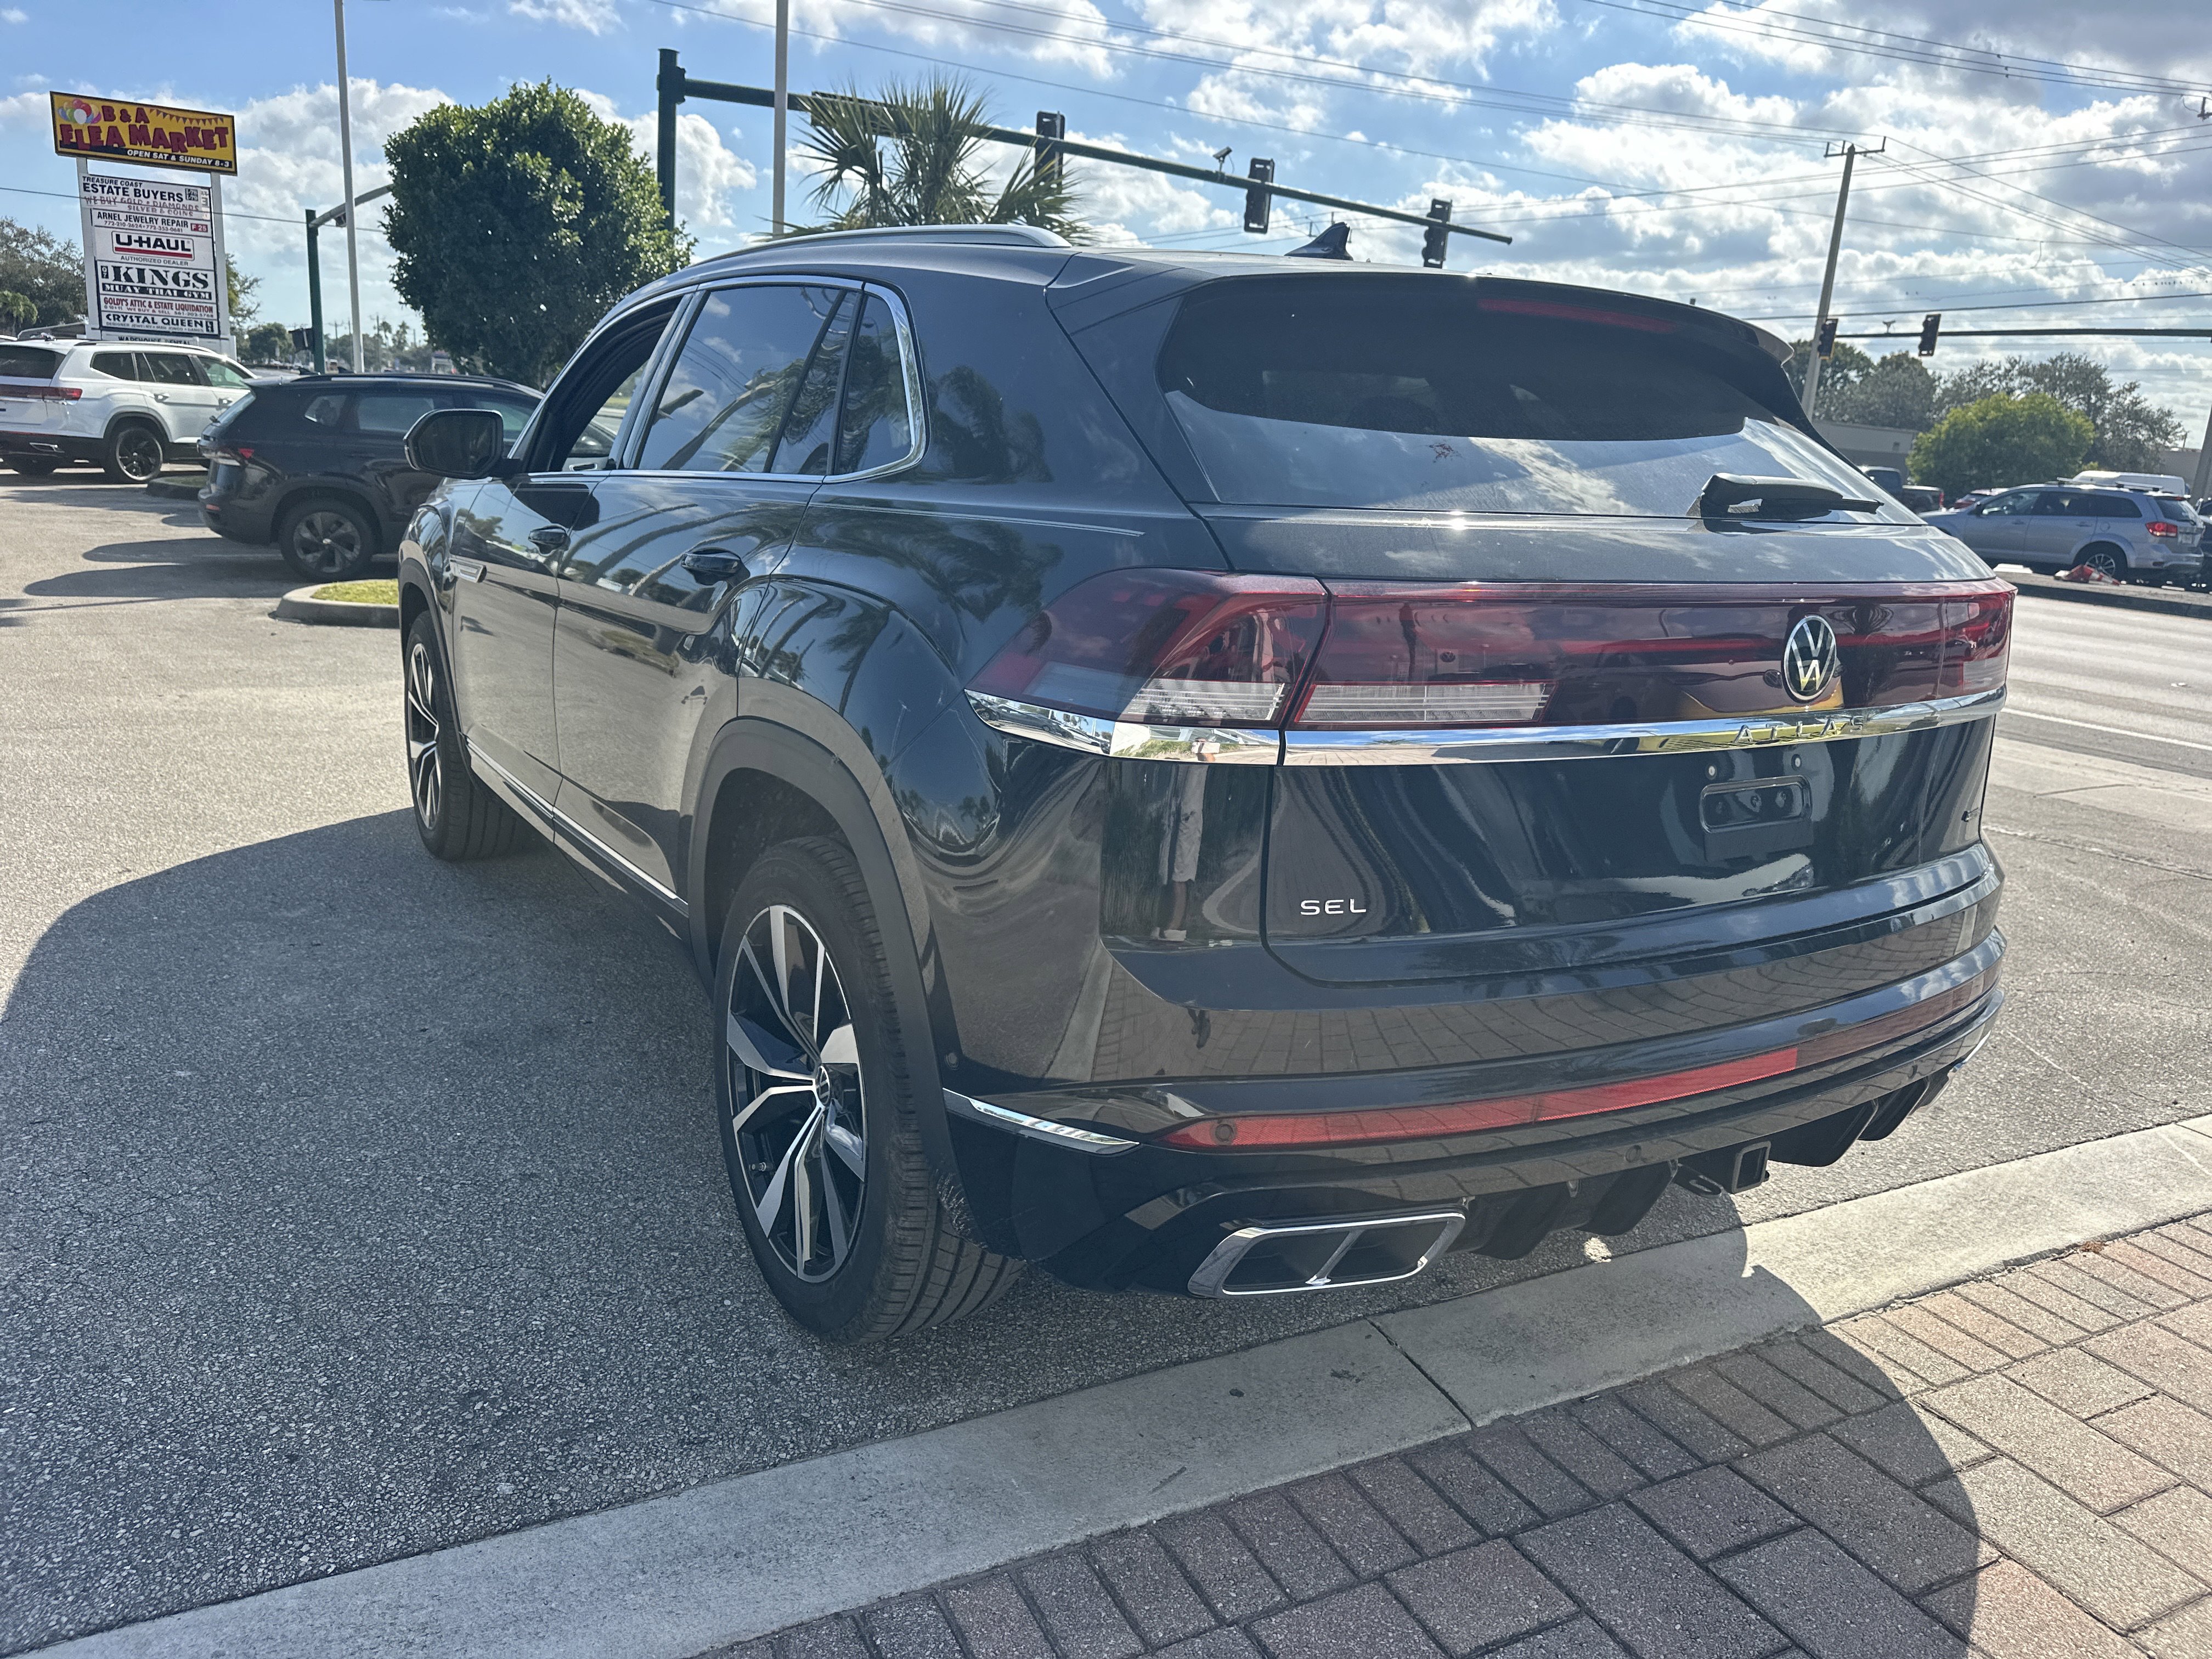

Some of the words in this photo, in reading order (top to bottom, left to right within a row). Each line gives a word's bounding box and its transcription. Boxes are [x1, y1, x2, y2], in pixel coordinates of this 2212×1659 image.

[101, 105, 116, 121] B
[120, 109, 132, 122] &
[135, 108, 150, 123] A
[60, 124, 126, 150] FLEA
[128, 124, 228, 153] MARKET
[127, 149, 150, 159] OPEN
[152, 152, 168, 160] SAT
[179, 155, 213, 165] SUNDAY
[82, 176, 118, 185] TREASURE
[83, 182, 129, 196] ESTATE
[133, 188, 183, 202] BUYERS
[84, 196, 98, 205] WE
[100, 196, 117, 205] BUY
[153, 201, 199, 211] DIAMONDS
[127, 205, 156, 213] SILVER
[97, 212, 122, 221] ARNEL
[124, 215, 159, 225] JEWELRY
[161, 218, 188, 228] REPAIR
[116, 234, 191, 252] U-HAUL
[121, 255, 161, 264] AUTHORIZED
[163, 258, 189, 267] DEALER
[111, 266, 208, 289] KINGS
[105, 284, 140, 294] MUAY
[146, 287, 177, 296] THAI
[184, 291, 209, 299] GYM
[104, 297, 128, 306] GOLDY'S
[130, 299, 146, 308] ATTIC
[154, 301, 173, 310] ESTATE
[176, 303, 213, 313] LIQUIDATION
[106, 313, 157, 324] CRYSTAL
[161, 318, 203, 328] QUEEN
[1733, 715, 1864, 743] ATLAS
[1300, 899, 1367, 916] SEL
